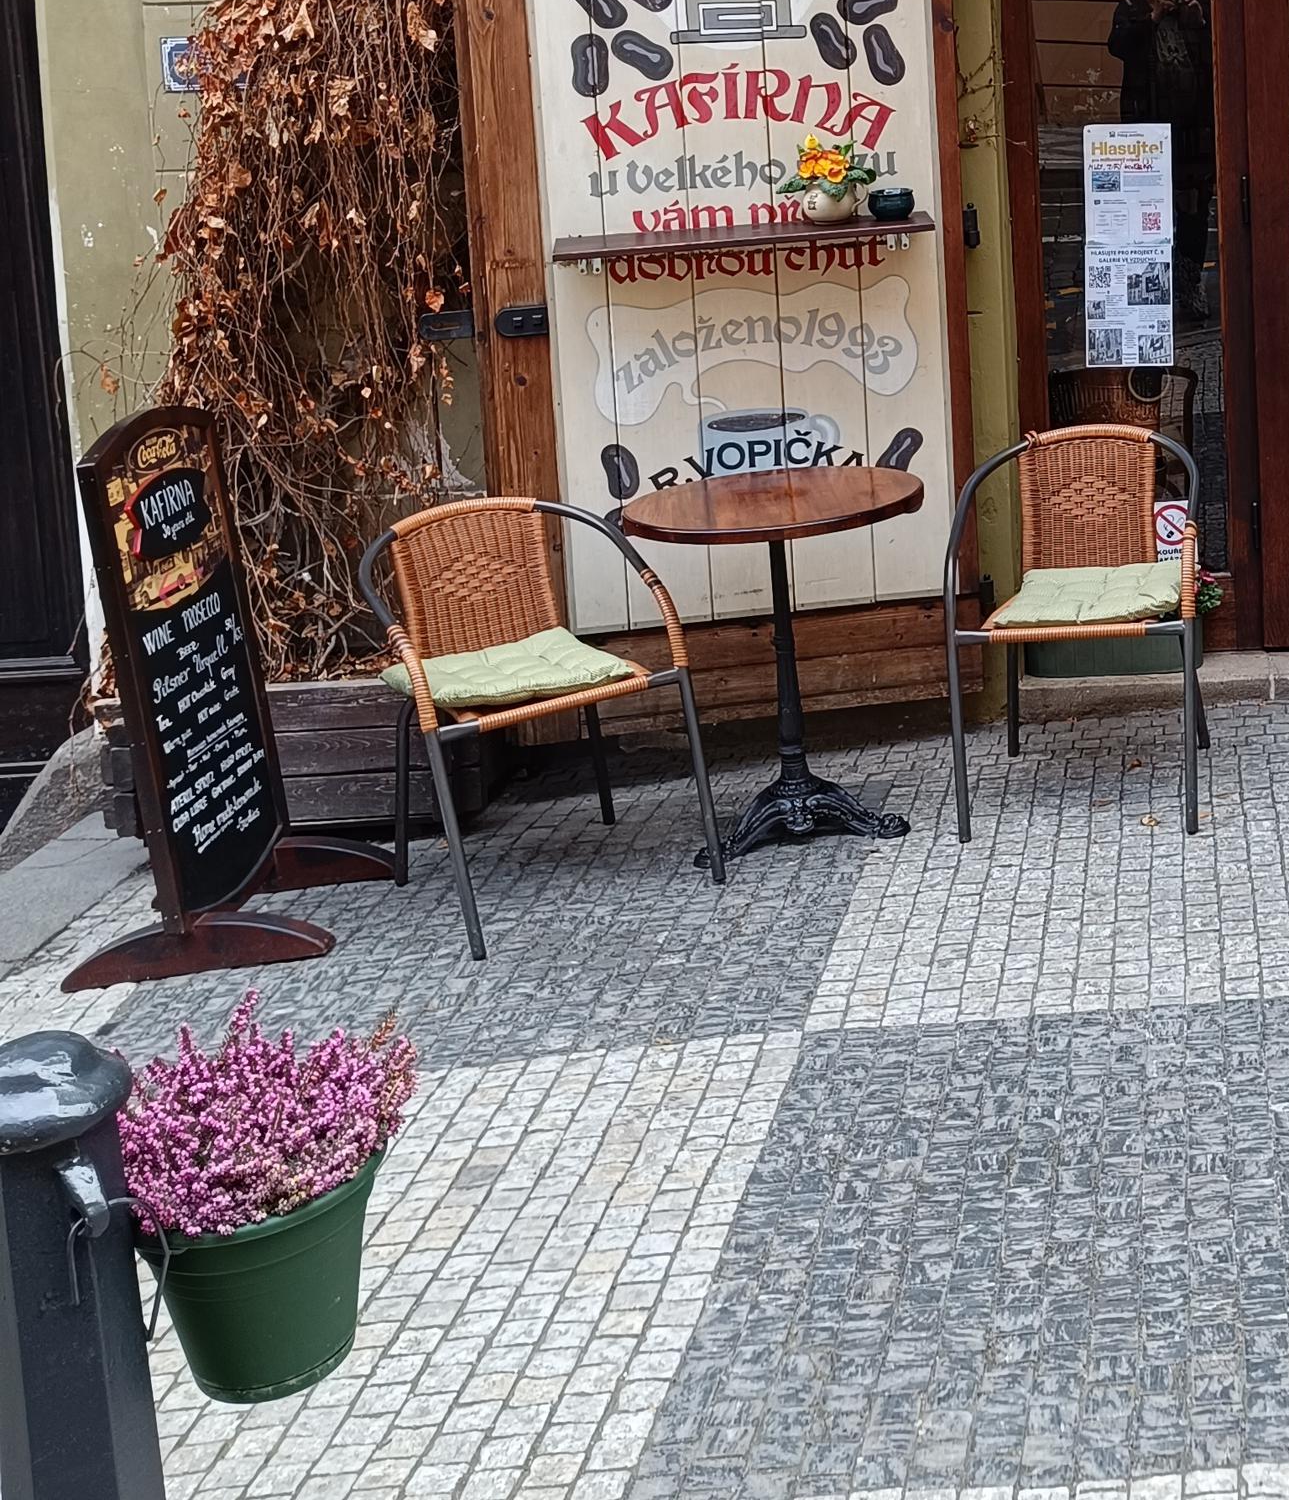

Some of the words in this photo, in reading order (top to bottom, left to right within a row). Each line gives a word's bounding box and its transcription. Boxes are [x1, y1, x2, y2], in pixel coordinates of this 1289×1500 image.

[579, 63, 898, 162] KAFÍRNA
[1091, 140, 1164, 157] Hlasujte!
[632, 199, 735, 233] vám
[142, 619, 176, 656] WINE
[152, 667, 191, 704] Pilsner
